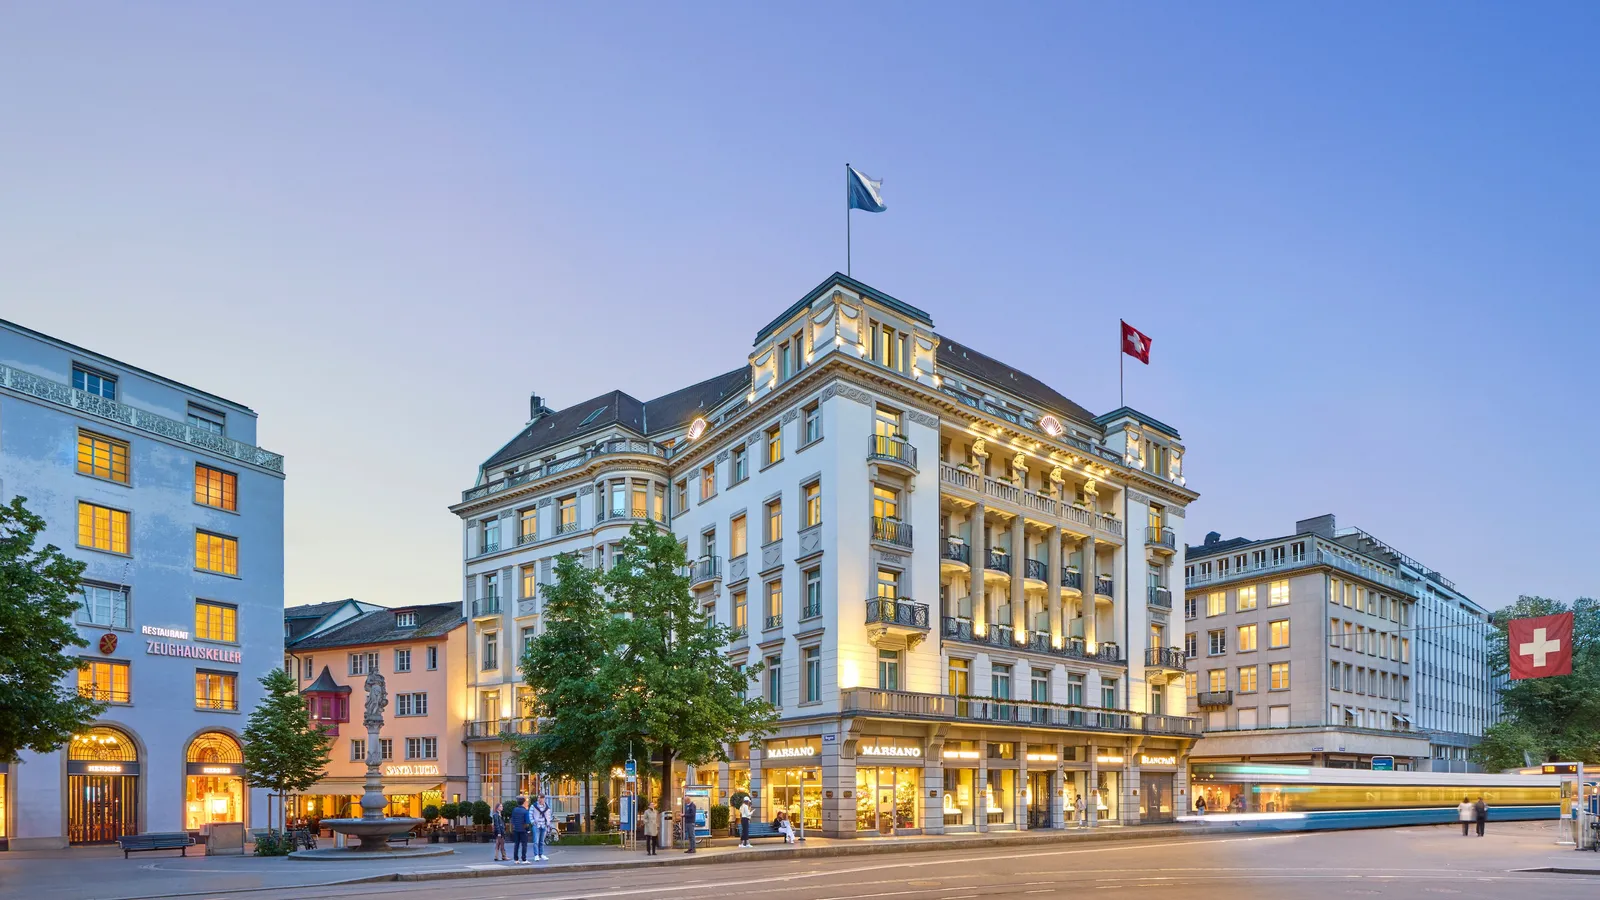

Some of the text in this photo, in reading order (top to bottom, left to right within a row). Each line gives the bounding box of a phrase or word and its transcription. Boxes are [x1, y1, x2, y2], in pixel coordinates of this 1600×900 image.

[142, 625, 189, 640] RESTAURANT
[146, 640, 242, 664] ZEUGHAUSKELLER
[768, 746, 815, 758] MARSANO
[862, 746, 921, 757] MARSANO
[386, 765, 439, 776] SANTA LUCIA
